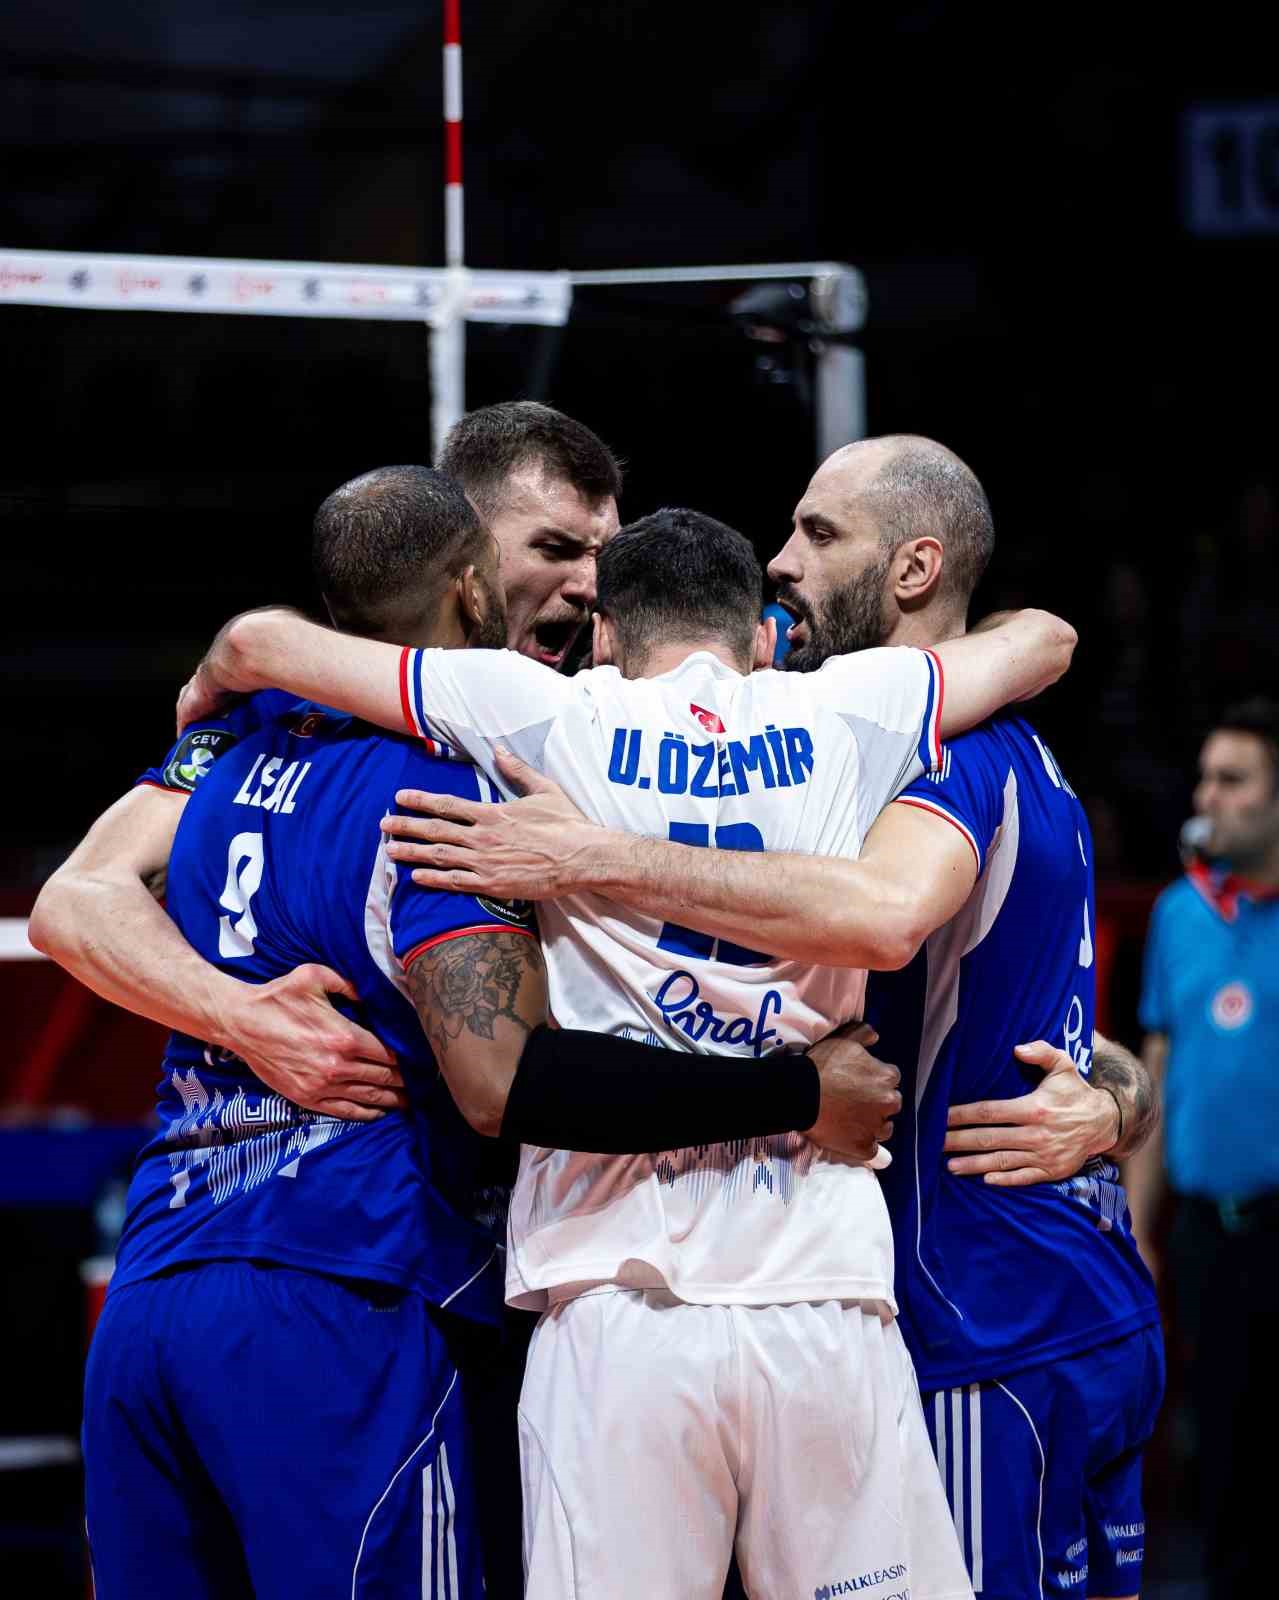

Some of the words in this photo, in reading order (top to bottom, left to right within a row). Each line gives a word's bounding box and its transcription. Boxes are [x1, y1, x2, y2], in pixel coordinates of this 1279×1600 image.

[191, 734, 220, 746] CEV
[232, 753, 313, 814] LEAL
[218, 831, 265, 958] 9
